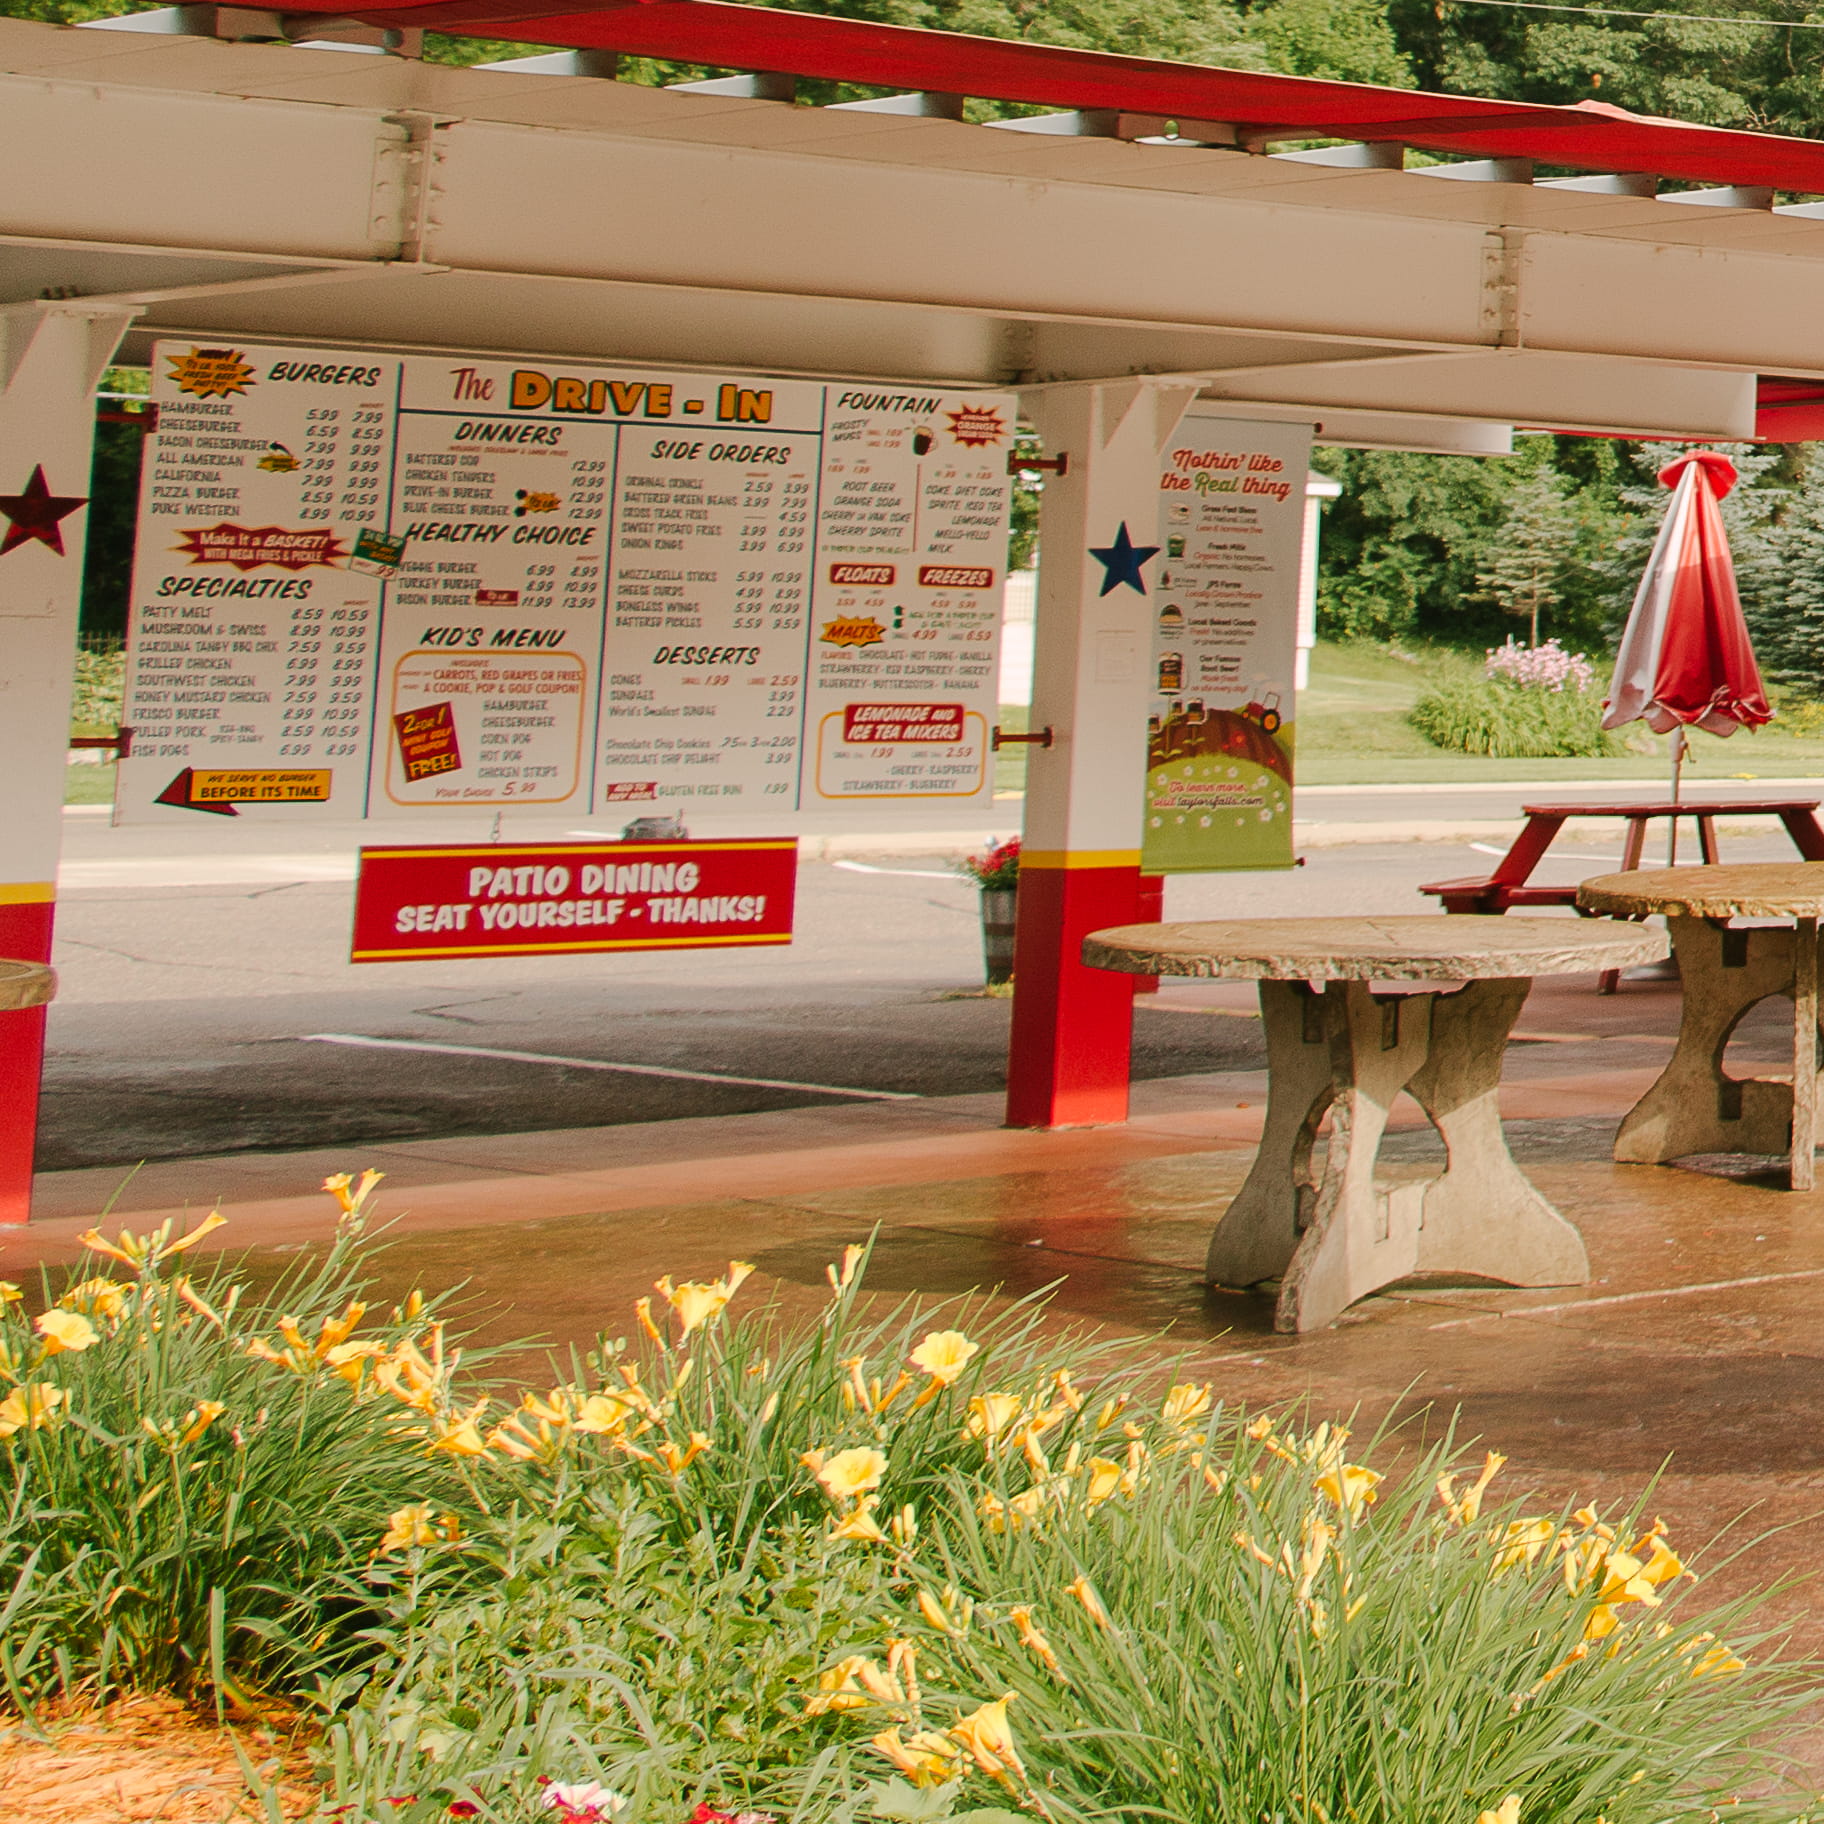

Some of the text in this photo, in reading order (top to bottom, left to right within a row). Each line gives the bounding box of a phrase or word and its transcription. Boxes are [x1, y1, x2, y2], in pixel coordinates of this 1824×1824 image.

[268, 361, 382, 387] BURGERS
[449, 367, 495, 401] The
[509, 369, 674, 419] DRIVE
[716, 383, 773, 424] IN
[837, 392, 943, 415] FOUNTAIN
[160, 401, 234, 416] HAMBURGER
[306, 409, 385, 423] 5.99 7.99
[159, 418, 241, 433] CHEESEBURGER
[453, 421, 563, 446] DINNERS
[156, 452, 244, 467] ALL AMERICAN
[650, 439, 791, 465] SIDE ORDERS
[1171, 448, 1284, 472] Nothin' like
[155, 469, 221, 482] CALIFORNIA
[1160, 471, 1292, 502] the Real thing
[200, 531, 235, 546] Make
[252, 536, 262, 546] a
[263, 533, 328, 548] BASKET!
[401, 521, 596, 546] HEALTHY CHOICE
[833, 566, 894, 584] FLOATS
[922, 568, 990, 586] FREEZES
[155, 575, 313, 600] SPECIALTIES
[142, 606, 213, 618] PATTY MELT
[419, 626, 567, 648] KID'S MENU
[827, 624, 879, 641] MALTS
[652, 645, 761, 666] DESSERTS
[853, 706, 930, 722] LEMONADE
[847, 724, 961, 741] ICE TEA MIXERS
[408, 752, 458, 778] FREE!
[200, 785, 322, 798] BEFORE ITS TIME
[468, 861, 700, 899] PATIO DINING
[395, 904, 472, 933] SEAT
[478, 899, 625, 931] YOURSELF
[646, 894, 767, 924] THANKS!
